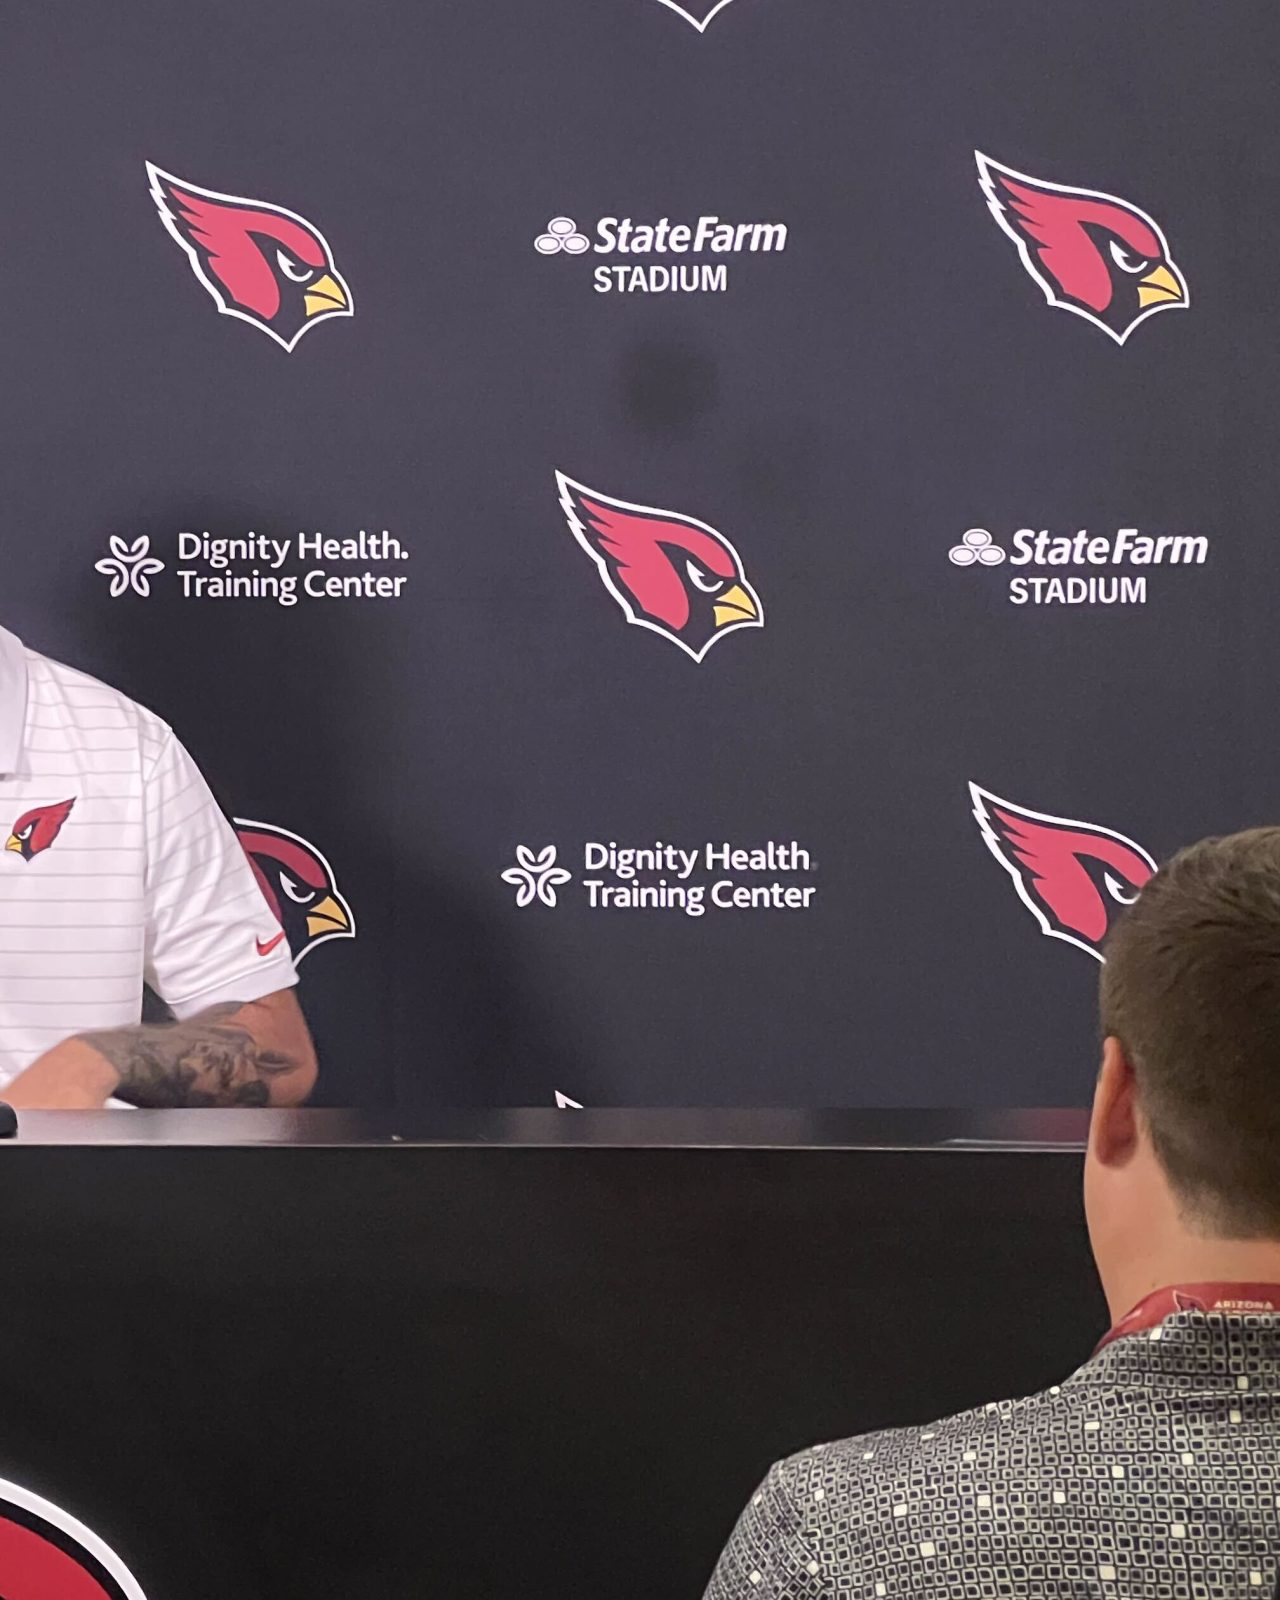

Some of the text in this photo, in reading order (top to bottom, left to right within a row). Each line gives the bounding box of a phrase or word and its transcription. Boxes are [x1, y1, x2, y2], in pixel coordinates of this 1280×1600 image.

[593, 264, 727, 293] STADIUM
[178, 531, 292, 568] Dignity
[176, 569, 408, 606] Training Center
[1009, 576, 1147, 605] STADIUM
[584, 840, 810, 879] Dignity Health
[582, 879, 817, 917] Training Center
[1213, 1300, 1275, 1311] ARIZONA
